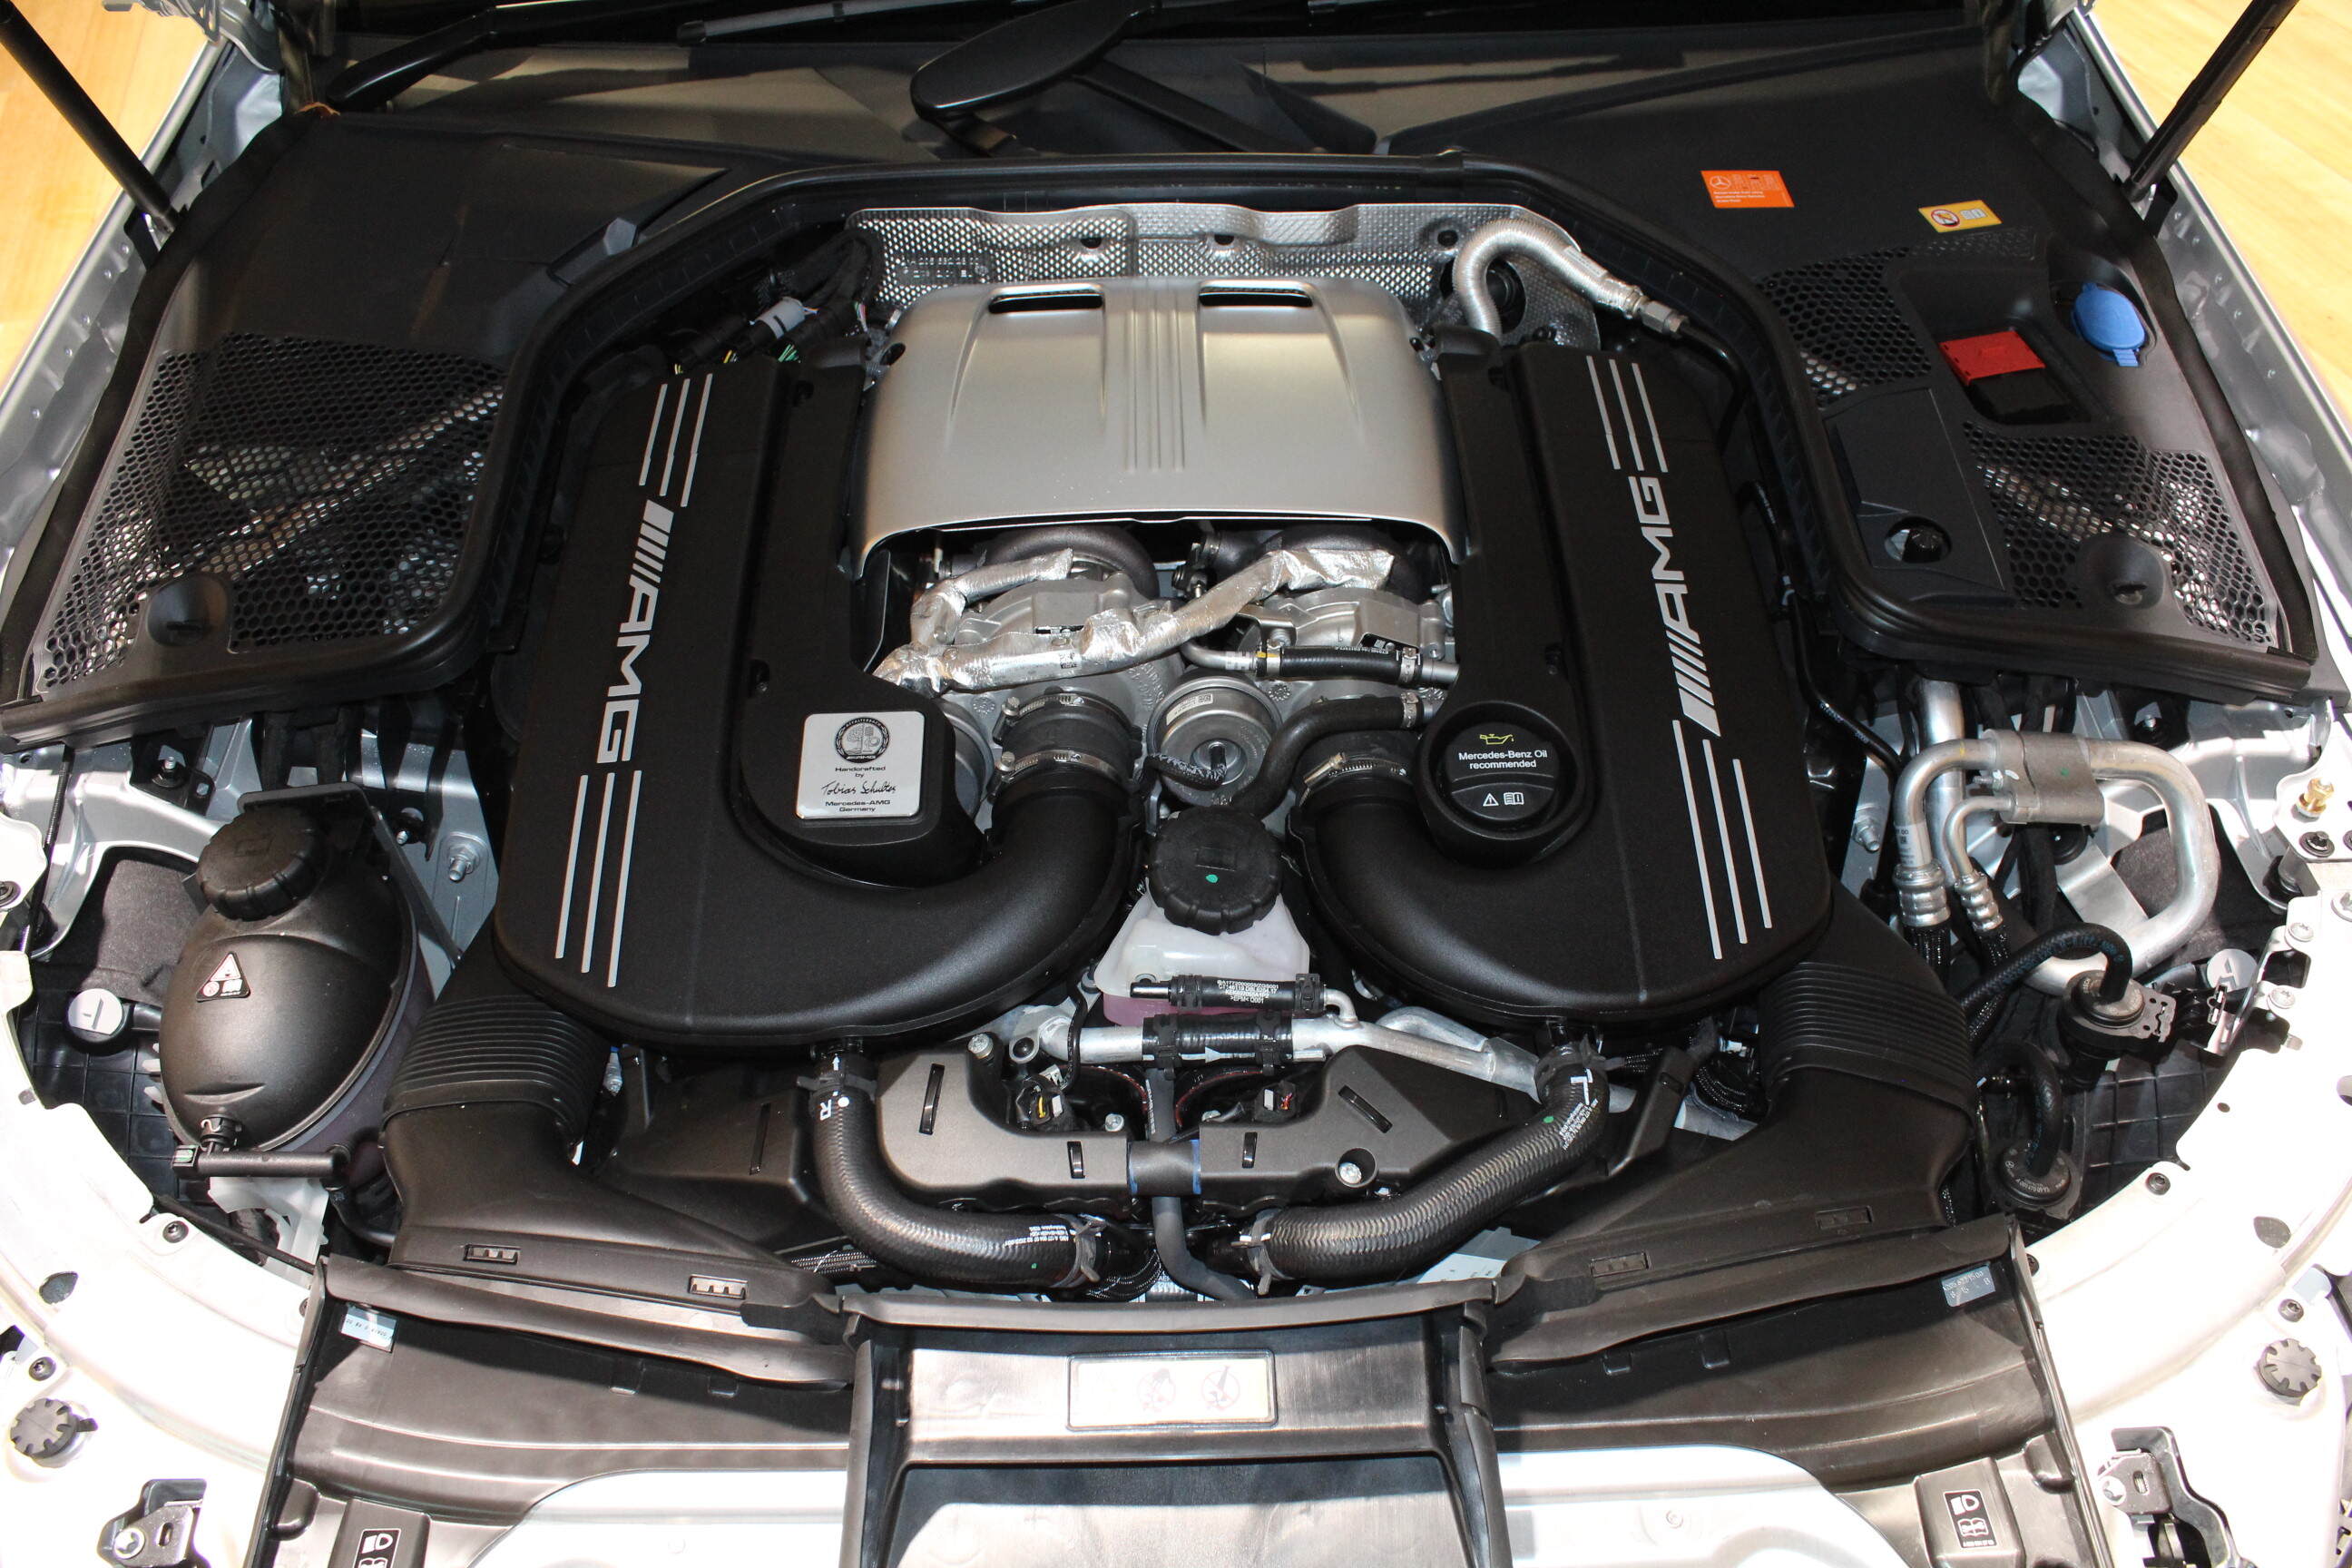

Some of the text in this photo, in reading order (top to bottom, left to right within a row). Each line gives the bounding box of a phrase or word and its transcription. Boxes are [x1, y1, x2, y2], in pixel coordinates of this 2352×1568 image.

[1458, 750, 1548, 760] Mercedes-Benz Oil
[1469, 760, 1537, 769] recommended
